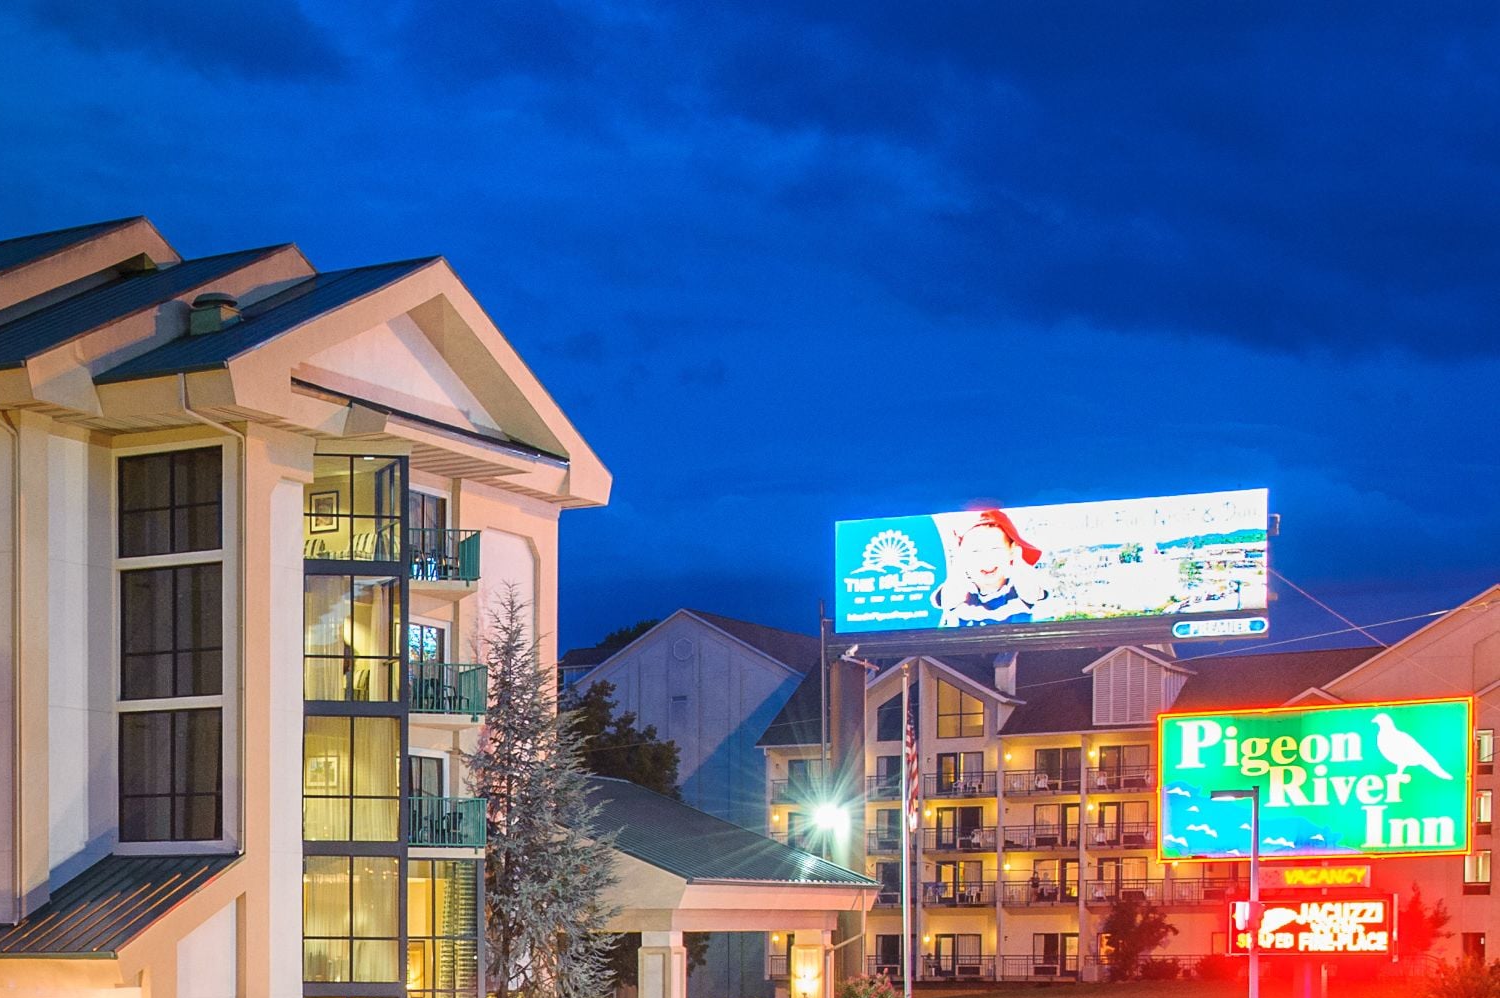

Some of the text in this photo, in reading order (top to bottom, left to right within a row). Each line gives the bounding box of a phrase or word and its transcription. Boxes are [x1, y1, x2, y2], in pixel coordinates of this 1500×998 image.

[1175, 719, 1363, 777] Pigeon
[1264, 763, 1412, 808] River
[1360, 804, 1457, 849] Inn
[1284, 867, 1367, 885] VACANCY
[1296, 901, 1384, 925] JACUZZI
